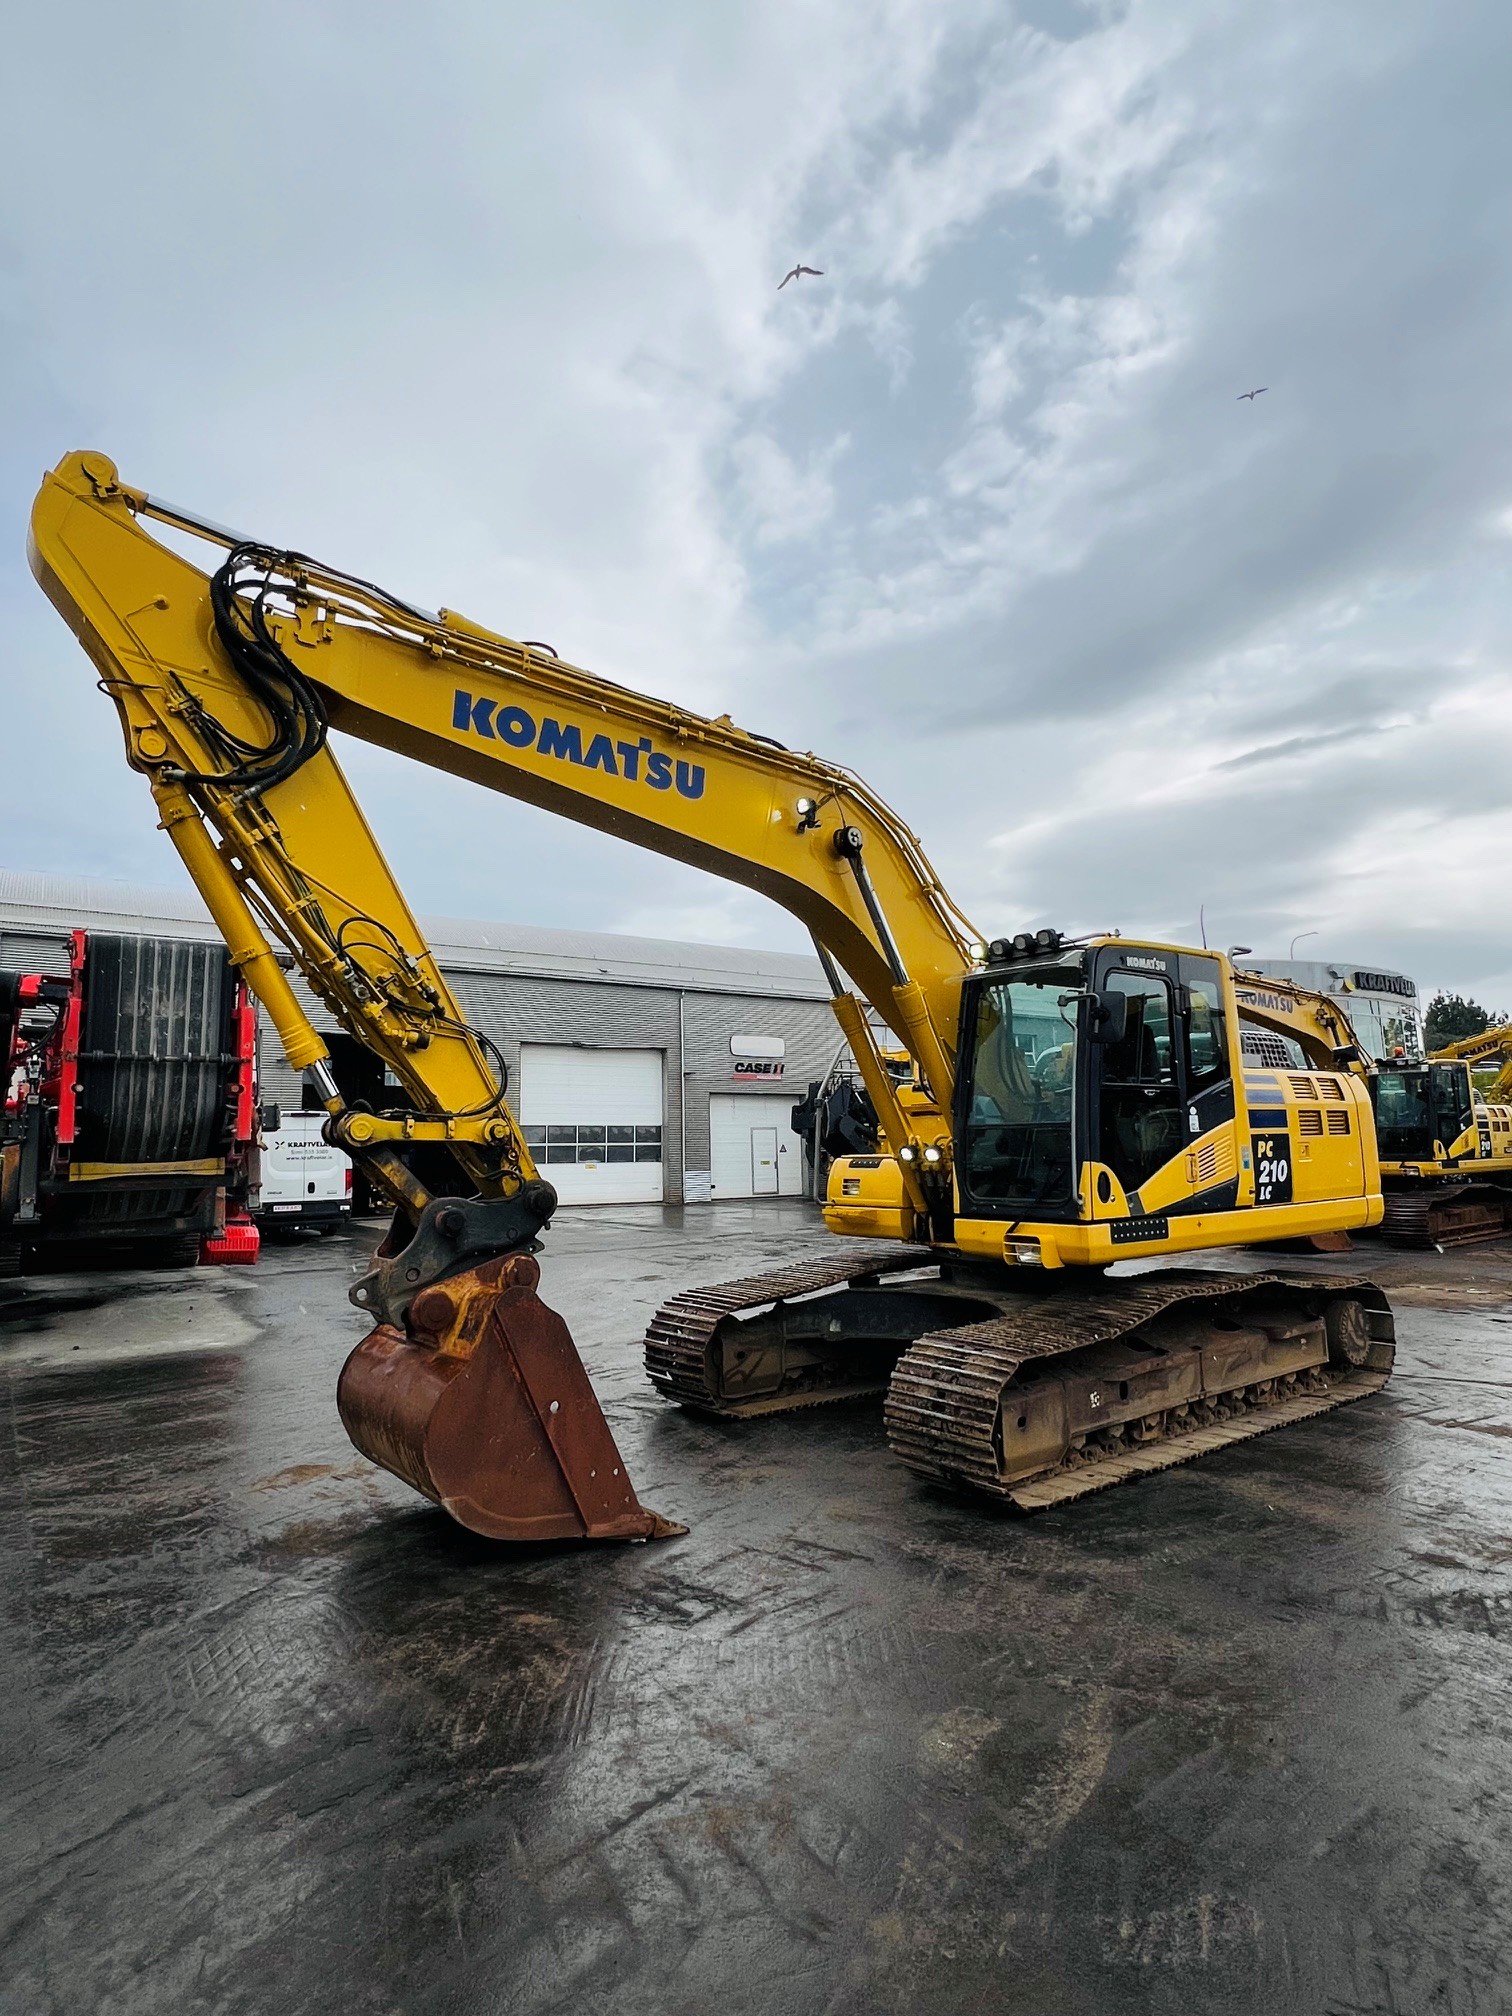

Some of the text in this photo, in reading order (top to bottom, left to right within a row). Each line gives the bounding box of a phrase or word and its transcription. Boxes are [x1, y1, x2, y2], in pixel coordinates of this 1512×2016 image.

[452, 688, 706, 799] KOMATSU
[1126, 956, 1166, 971] KOMATSU
[735, 1062, 772, 1073] CASE
[1258, 1140, 1274, 1158] PC
[1258, 1159, 1288, 1183] 210
[1259, 1185, 1273, 1200] LC
